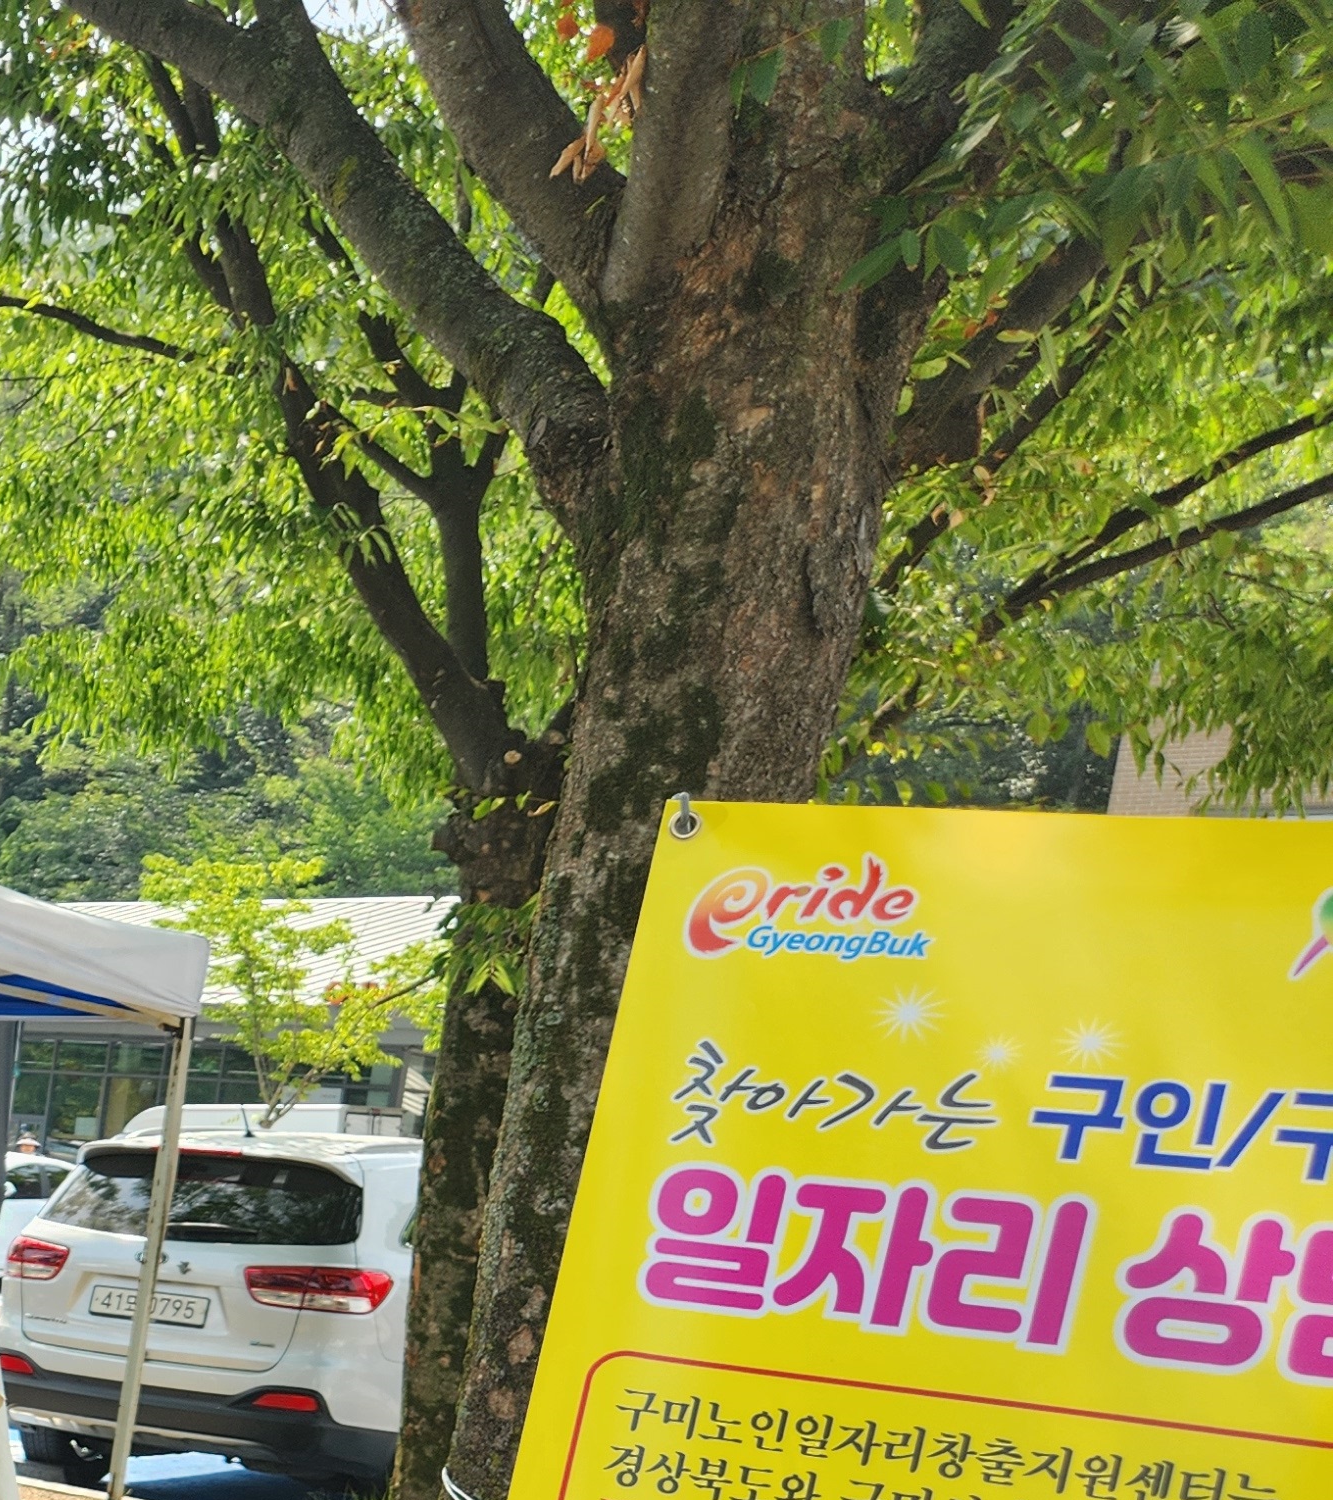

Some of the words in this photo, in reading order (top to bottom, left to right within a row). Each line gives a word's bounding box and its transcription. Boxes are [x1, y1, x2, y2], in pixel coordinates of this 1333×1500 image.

[747, 926, 931, 958] GyeongBuk
[672, 1041, 1001, 1149] 찾아가는
[647, 1169, 1088, 1345] 일자리
